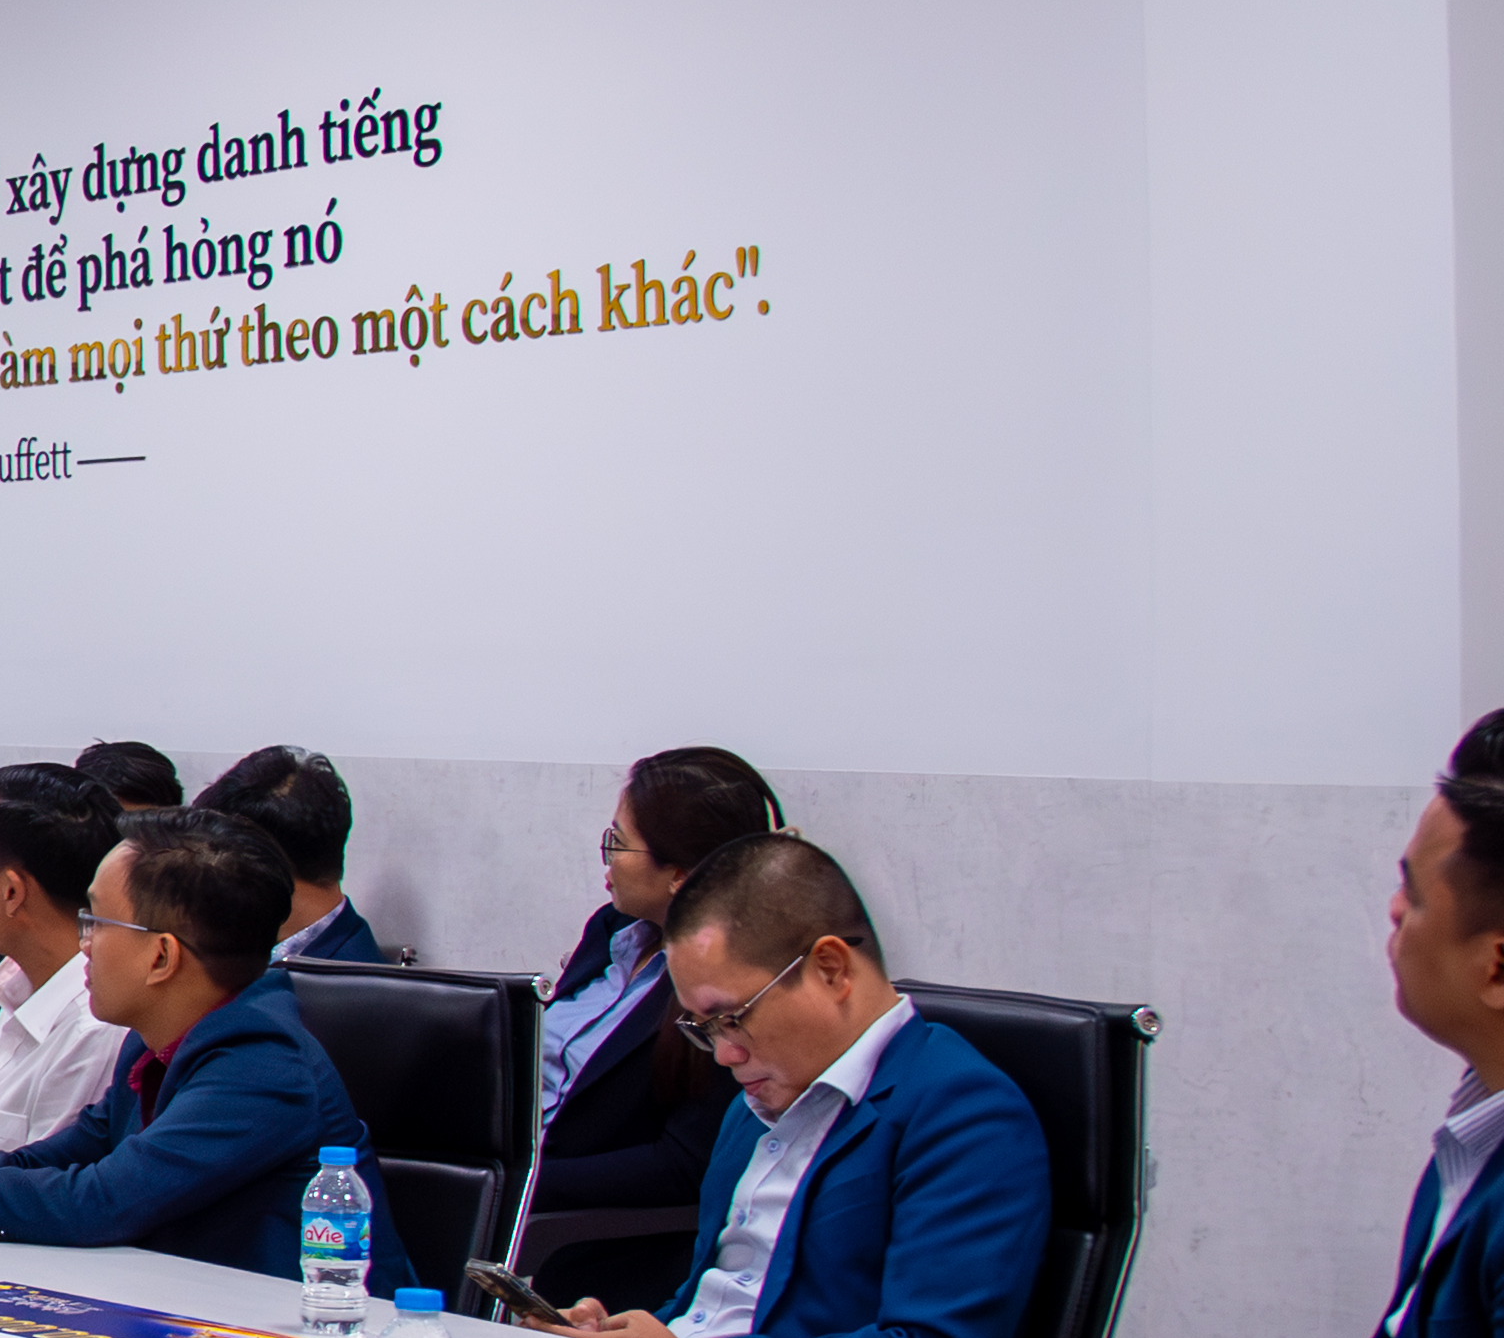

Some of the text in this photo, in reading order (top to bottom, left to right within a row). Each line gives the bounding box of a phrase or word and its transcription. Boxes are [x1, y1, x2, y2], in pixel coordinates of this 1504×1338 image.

[6, 153, 74, 225] xây
[82, 142, 187, 213] dựng
[197, 108, 307, 185] danh
[319, 87, 443, 168] tiếng
[20, 237, 68, 305] để
[76, 223, 152, 312] phá
[162, 217, 274, 291] hỏng
[283, 197, 344, 270] nó
[67, 317, 146, 395] mọi
[155, 306, 232, 377] thứ
[239, 303, 339, 367] theo
[351, 283, 450, 369] một
[461, 269, 584, 344] cách
